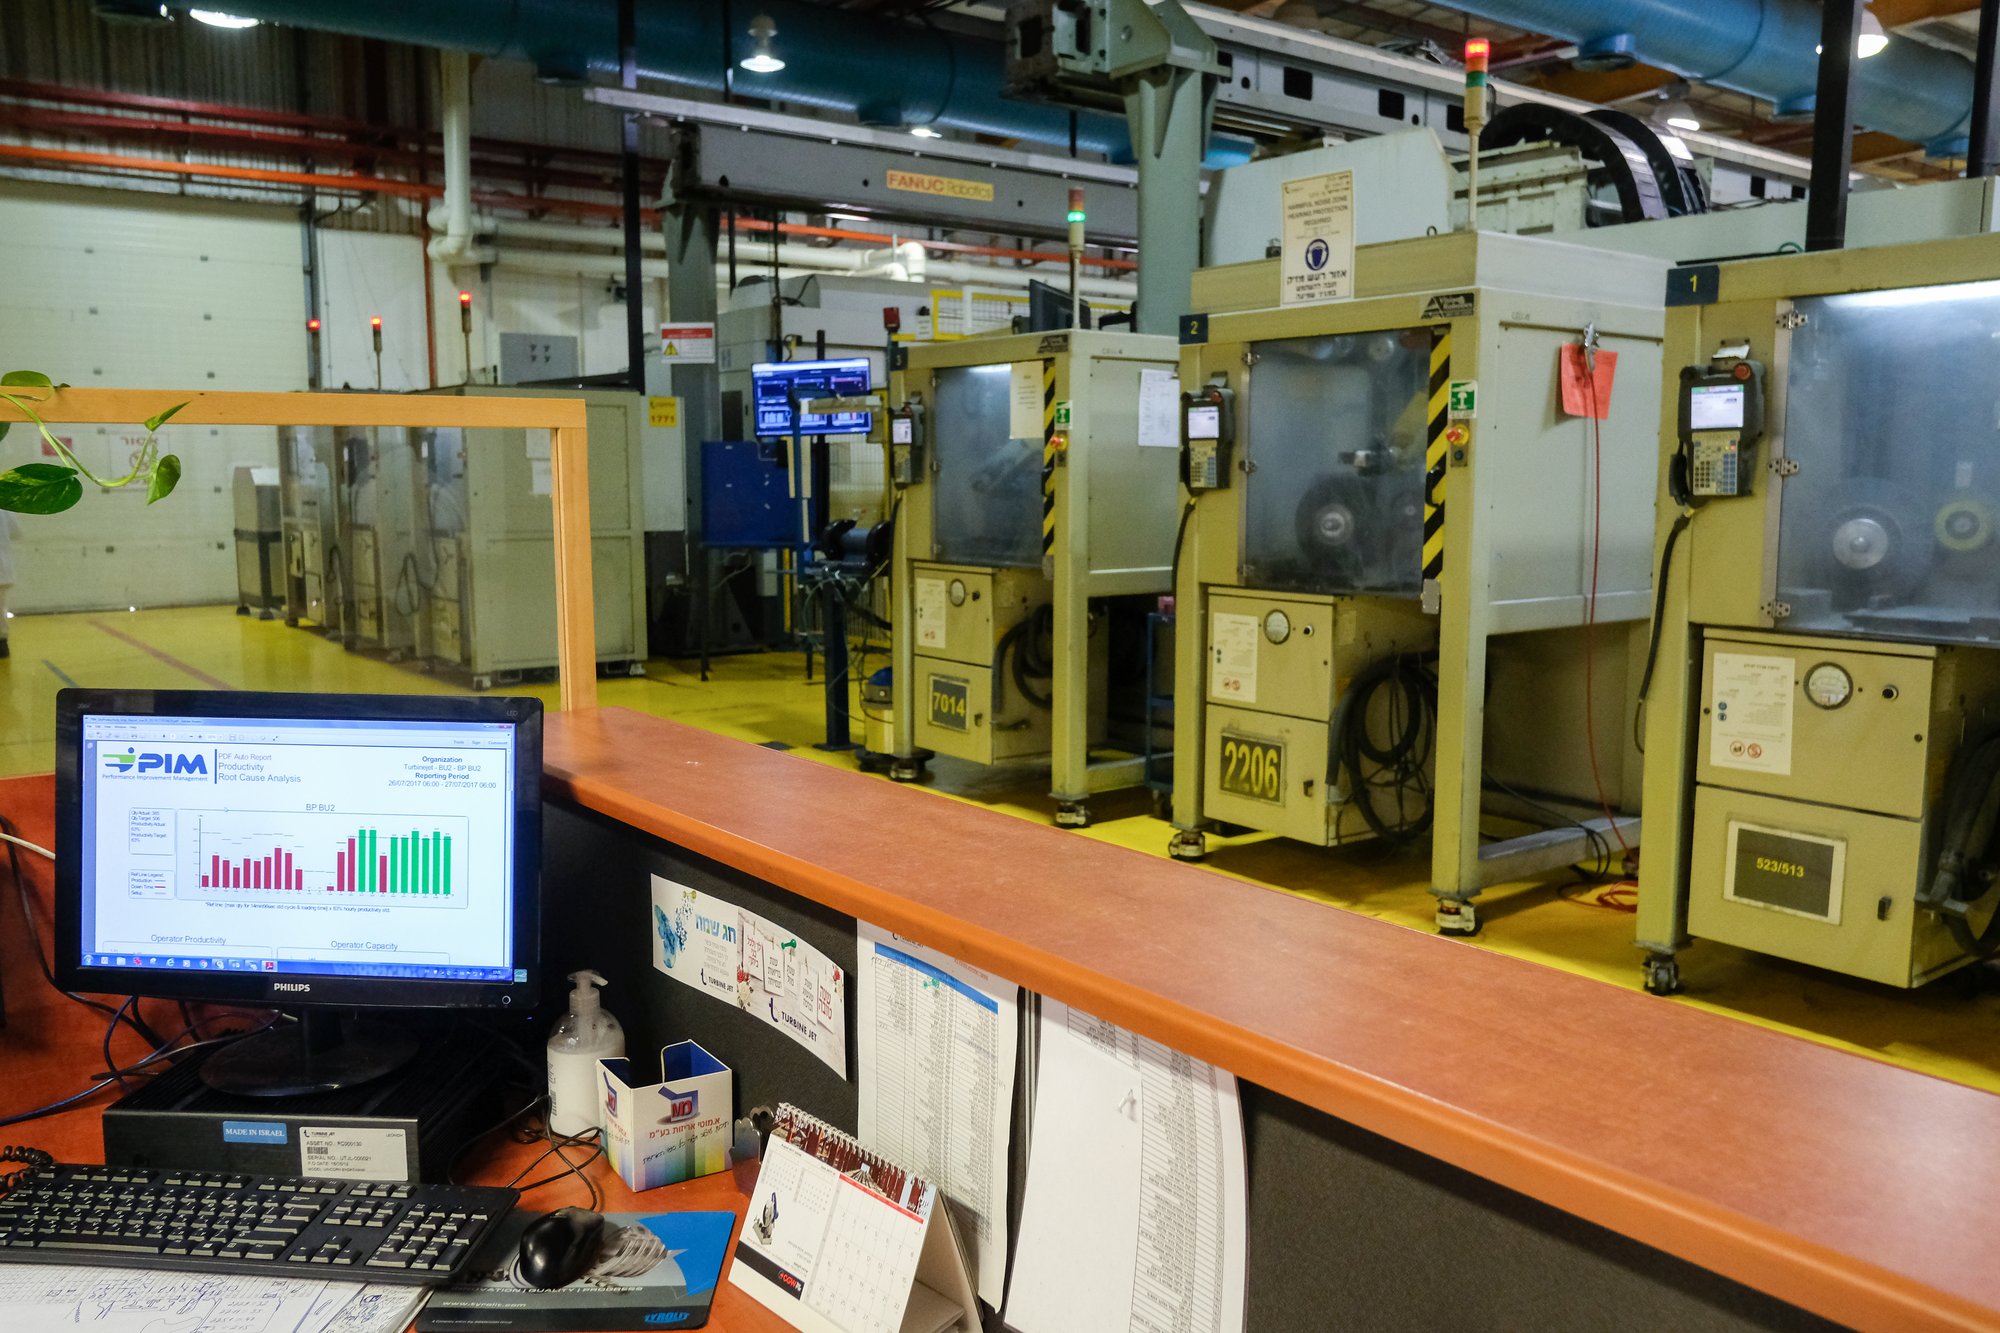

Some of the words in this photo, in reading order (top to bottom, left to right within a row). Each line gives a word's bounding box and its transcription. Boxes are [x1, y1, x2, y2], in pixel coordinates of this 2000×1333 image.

[889, 173, 944, 193] FANUC
[947, 181, 992, 199] Robotics
[1313, 205, 1348, 215] PROTECTION
[1690, 275, 1697, 293] 1
[1190, 321, 1199, 335] 2
[651, 415, 675, 423] 1771
[933, 692, 966, 717] 7014
[138, 753, 208, 774] PIM
[422, 756, 463, 764] Organization
[218, 762, 264, 772] Productivity
[1223, 741, 1278, 799] 2206
[218, 773, 237, 781] Root
[239, 773, 266, 782] Cause
[267, 774, 302, 784] Analysis
[318, 804, 336, 812] BU2
[1756, 857, 1805, 878] 523/513
[150, 934, 183, 943] Operator
[185, 935, 227, 946] Productivity
[722, 924, 737, 944] חג
[331, 940, 364, 949] Operator
[365, 942, 398, 951] Capacity
[273, 982, 310, 992] PHILIPS
[258, 1129, 285, 1137] ISRAEL
[672, 1122, 696, 1135] אריזות
[644, 1311, 690, 1323] TYROLIT
